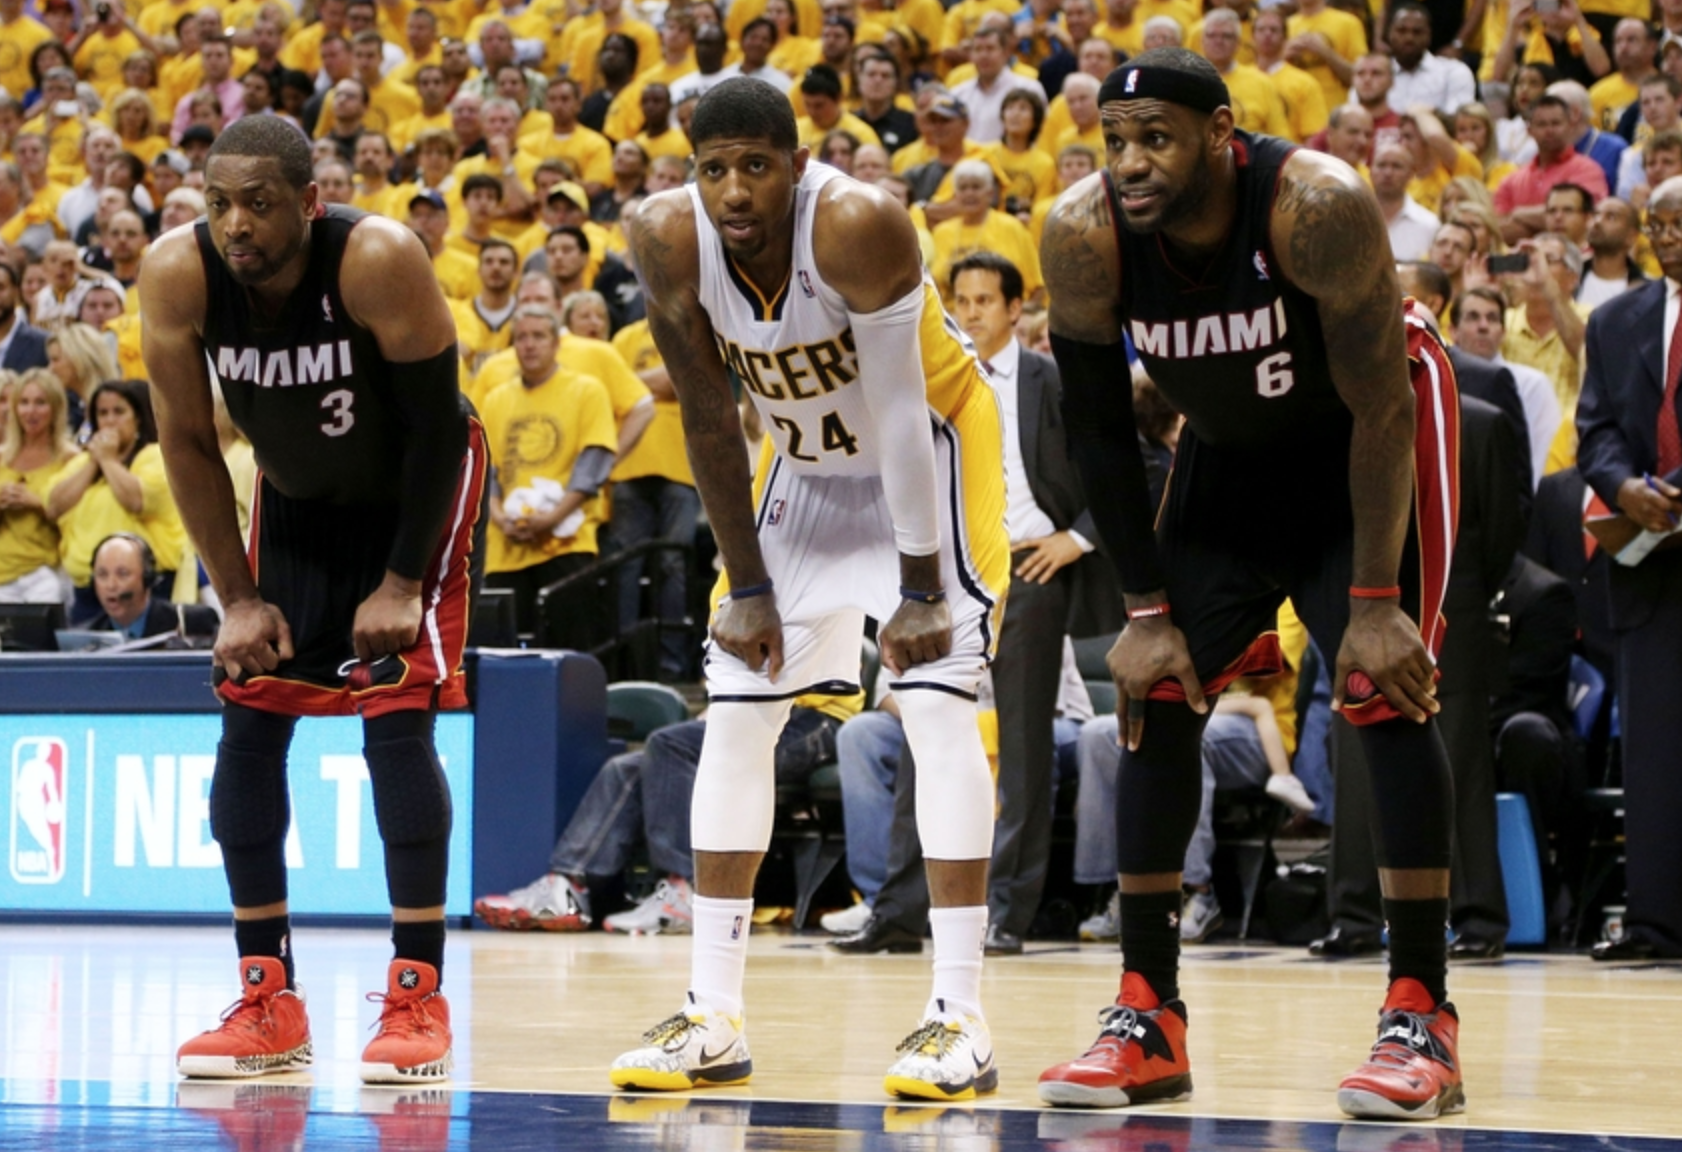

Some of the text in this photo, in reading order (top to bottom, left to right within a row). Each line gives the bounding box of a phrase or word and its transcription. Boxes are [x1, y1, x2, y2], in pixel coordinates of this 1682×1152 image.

[1131, 296, 1287, 358] MIAMI
[1256, 351, 1294, 399] 6
[321, 389, 354, 437] 3
[770, 411, 859, 462] 24
